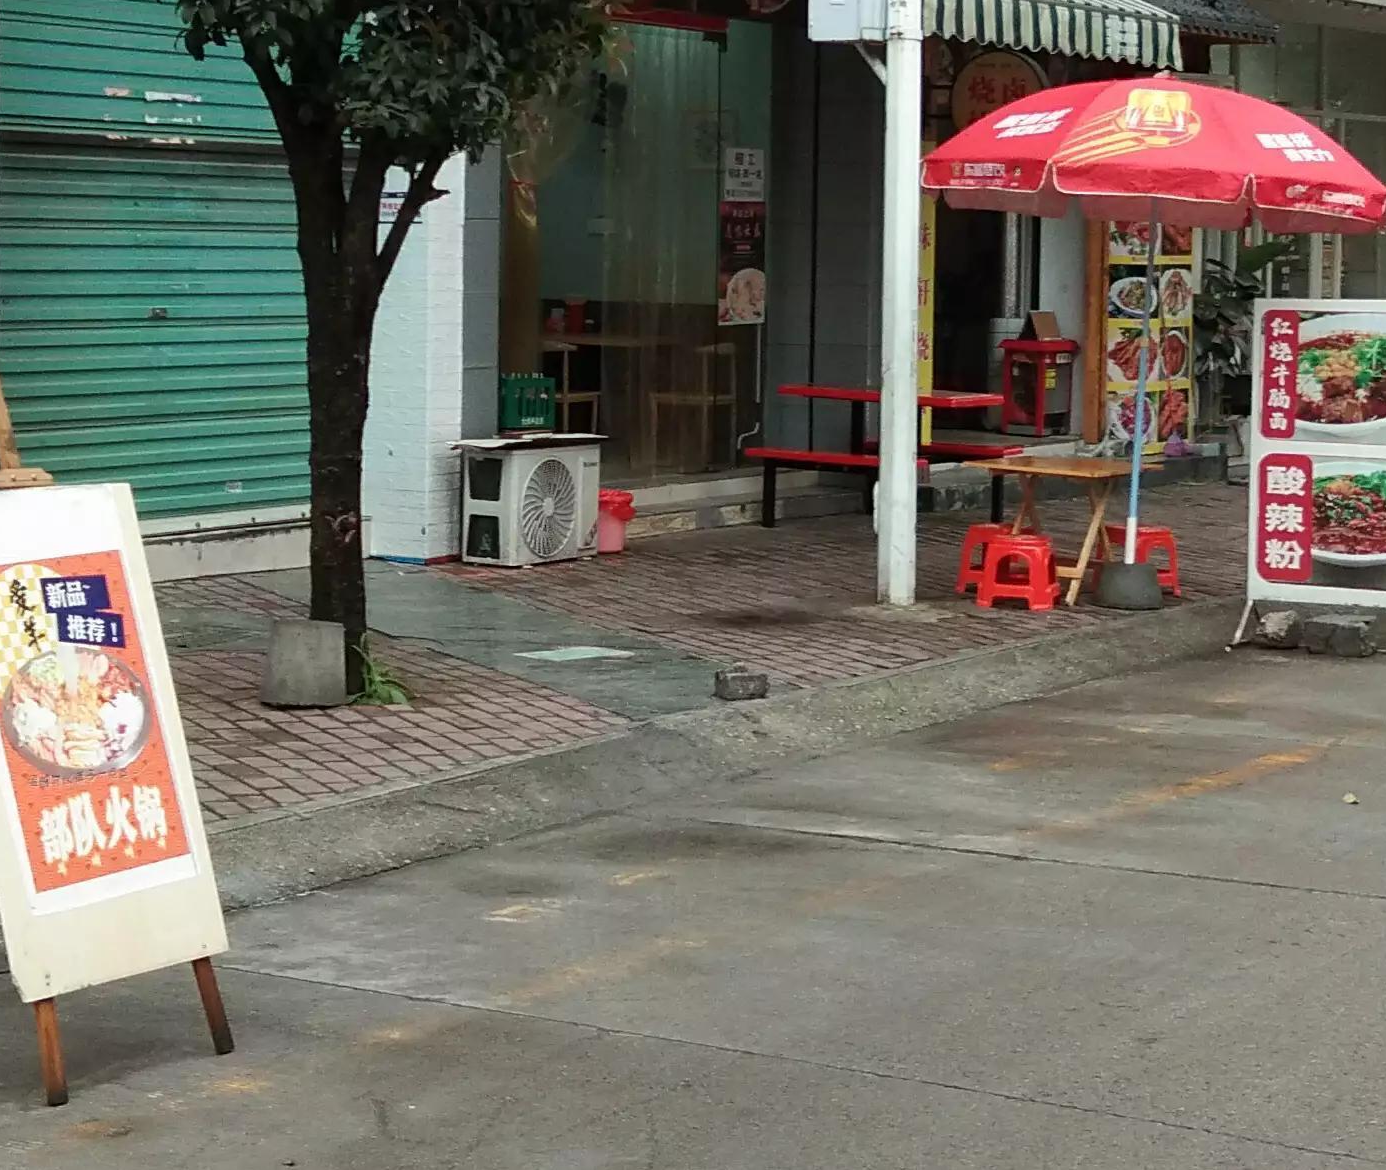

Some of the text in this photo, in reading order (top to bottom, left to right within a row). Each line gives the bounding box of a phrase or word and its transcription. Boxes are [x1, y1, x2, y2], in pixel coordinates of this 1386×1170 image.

[1264, 464, 1308, 571] 酸辣粉
[39, 784, 169, 864] 部队火锅
